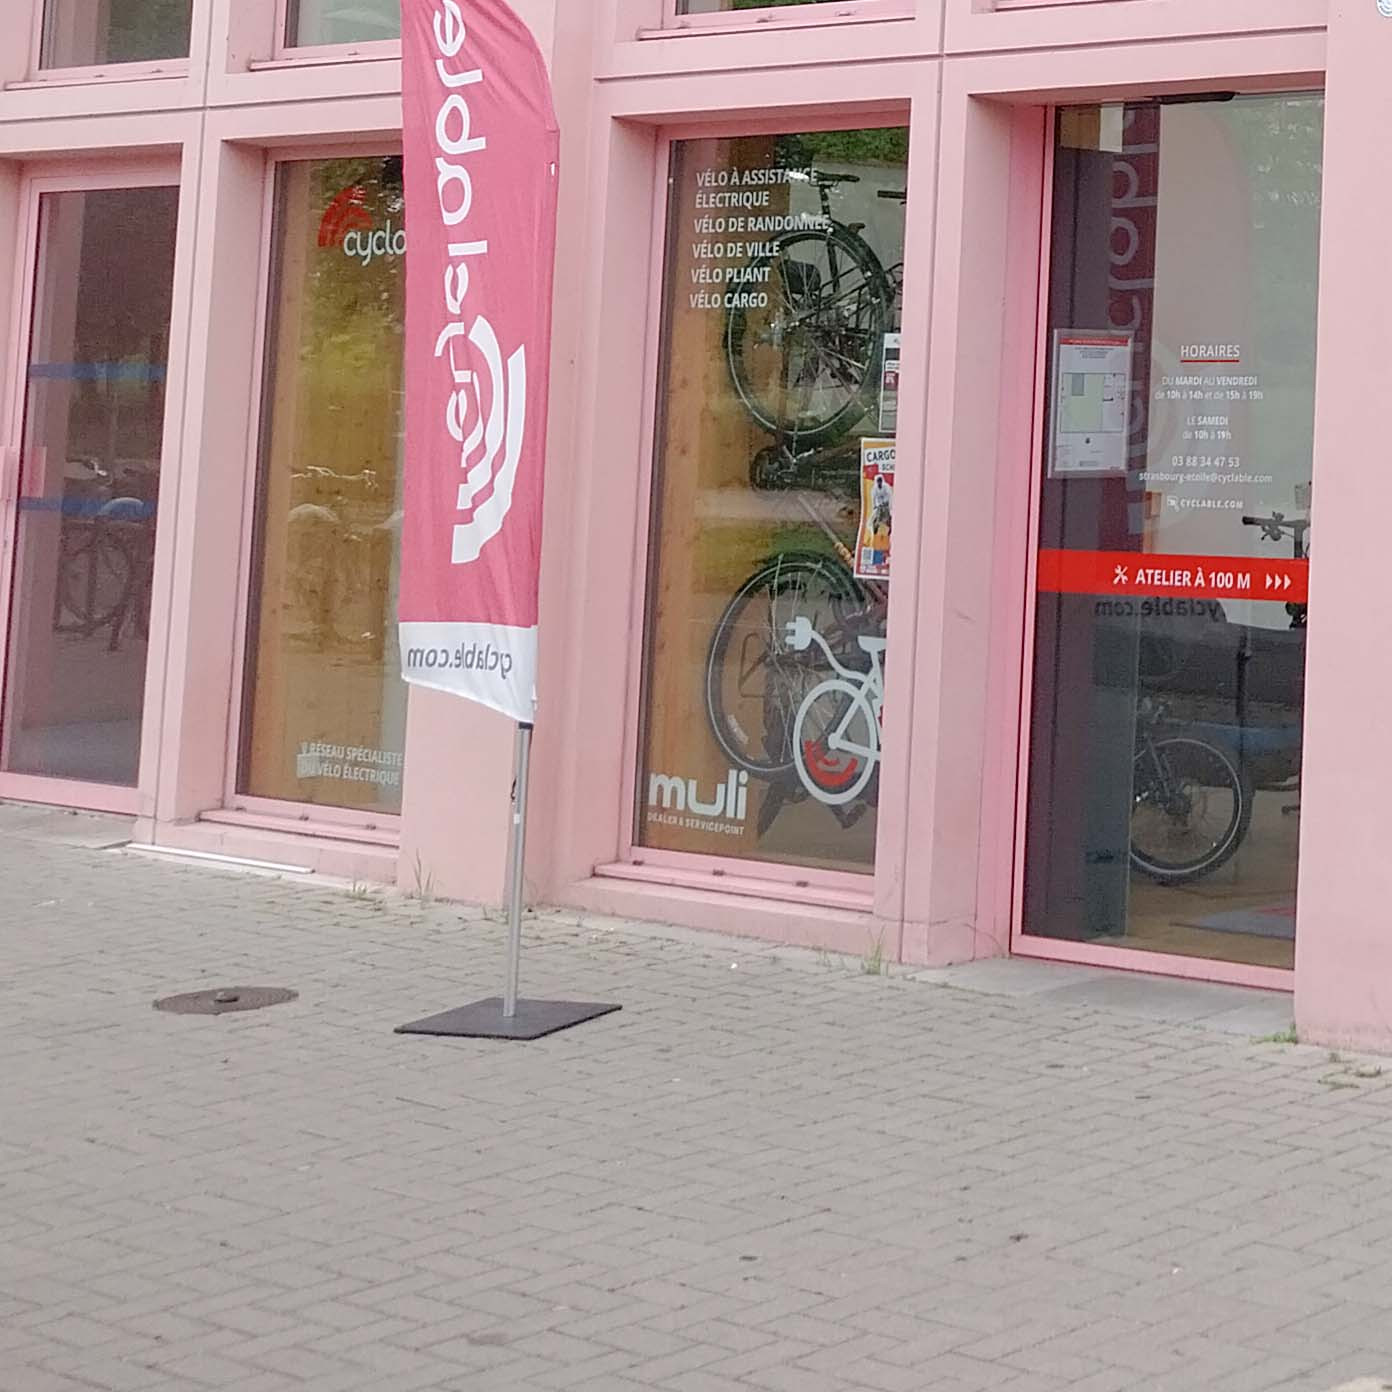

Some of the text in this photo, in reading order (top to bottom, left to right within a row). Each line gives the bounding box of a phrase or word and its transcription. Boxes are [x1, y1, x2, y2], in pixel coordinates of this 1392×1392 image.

[697, 169, 728, 186] VÉLO
[730, 167, 740, 185] À
[695, 191, 769, 209] ÉLECTRIQUE
[694, 215, 725, 233] VÉLO
[728, 217, 746, 230] DE
[693, 240, 780, 258] VÉLO DE VILLE
[691, 265, 771, 283] VÉLO PLIANT
[690, 290, 768, 308] VÉLO CARGO
[1181, 345, 1240, 357] HORAIRES
[1162, 376, 1257, 386] DU MARDI AU VENDREDI
[1167, 390, 1181, 399] 10h
[1189, 390, 1203, 399] 14h
[1226, 390, 1240, 399] 15h
[1198, 416, 1228, 425] SAMEDI
[1172, 456, 1184, 466] 03
[1135, 567, 1251, 589] ATELIER À 100 M
[648, 769, 748, 820] muli
